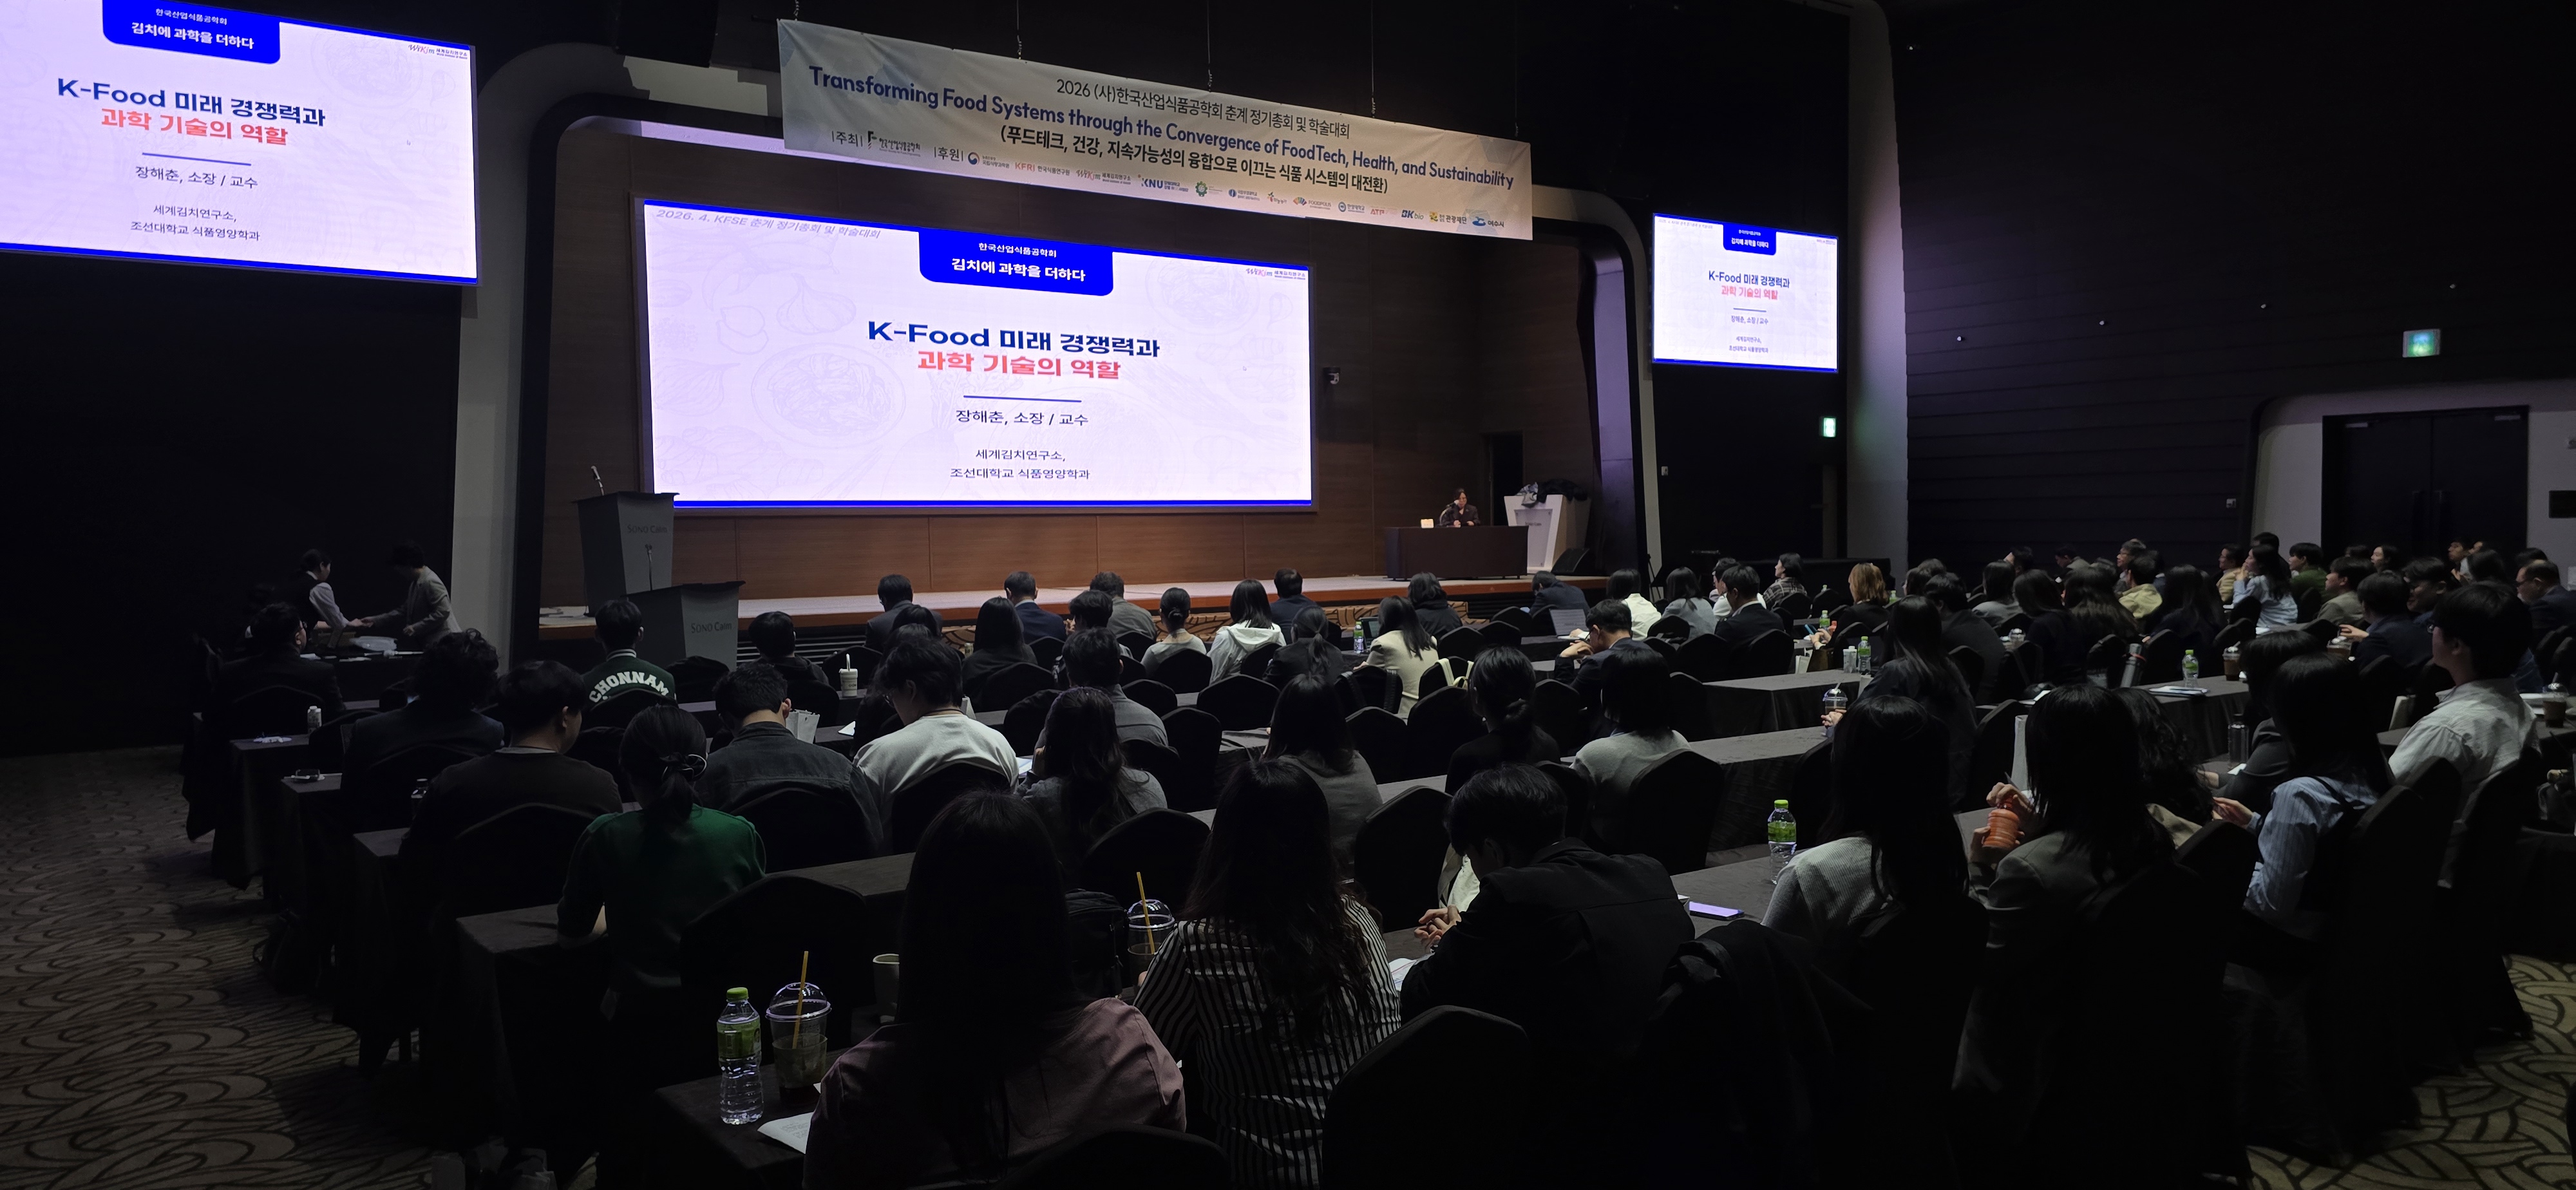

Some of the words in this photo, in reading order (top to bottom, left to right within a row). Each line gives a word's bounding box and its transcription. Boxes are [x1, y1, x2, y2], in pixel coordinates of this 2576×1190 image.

[156, 8, 228, 26] 한국산업식품공학회
[131, 22, 171, 40] 김치에
[174, 27, 213, 44] 과학을
[216, 32, 255, 50] 더하다
[57, 78, 166, 108] K-Food
[175, 91, 223, 115] 미래
[231, 98, 326, 128] 경쟁력과
[1056, 79, 1091, 98] 2026
[1094, 82, 1223, 120] (사)한국산업식품공학회
[1225, 104, 1248, 124] 춘계
[1249, 109, 1294, 131] 정기총회
[1296, 114, 1307, 133] 및
[1308, 117, 1350, 140] 학술대회
[101, 108, 152, 131] 과학
[160, 115, 233, 140] 기술의
[240, 122, 288, 146] 역할
[809, 65, 939, 109] Transforming
[943, 88, 987, 113] Food
[992, 96, 1065, 123] Systems
[1069, 105, 1133, 136] through
[1137, 113, 1162, 139] the
[1166, 123, 1261, 155] Convergence
[1264, 138, 1279, 156] of
[1282, 140, 1349, 168] FoodTech,
[1353, 151, 1398, 176] Health,
[1402, 160, 1426, 178] and
[1429, 162, 1514, 190] Sustainability
[1000, 124, 1068, 154] (푸드테크,
[1073, 134, 1103, 158] 건강,
[1107, 139, 1185, 168] 지속가능성의
[1188, 149, 1238, 174] 융합으로
[1240, 158, 1276, 180] 이끄는
[1279, 164, 1302, 183] 식품
[1305, 167, 1349, 190] 시스템의
[1351, 174, 1388, 194] 대전환)
[135, 165, 184, 185] 장해춘,
[188, 171, 216, 187] 소장
[230, 173, 259, 190] 교수
[1141, 178, 1163, 189] KNU
[153, 204, 238, 224] 세계김치연구소,
[656, 209, 694, 222] 2026.
[698, 213, 710, 223] 4.
[714, 215, 747, 226] KFSE
[131, 221, 189, 236] 조선대학교
[193, 225, 261, 241] 식품영양학과
[978, 242, 1057, 258] 한국산업식품공학회
[952, 258, 996, 276] 김치에
[999, 261, 1041, 279] 과학을
[1045, 266, 1086, 283] 더하다
[1709, 270, 1741, 283] K-Food
[1744, 274, 1759, 285] 미래
[1721, 285, 1737, 296] 과학
[868, 321, 990, 348] K-Food
[1000, 329, 1052, 352] 미래
[1060, 333, 1160, 358] 경쟁력과
[918, 350, 974, 373] 과학
[983, 354, 1062, 377] 기술의
[1070, 359, 1121, 380] 역할
[956, 409, 1009, 426] 장해춘,
[1014, 410, 1043, 426] 소장
[1048, 413, 1055, 426] /
[1059, 412, 1088, 428] 교수
[976, 449, 1066, 463] 세계김치연구소,
[951, 467, 1014, 480] 조선대학교
[1018, 468, 1090, 481] 식품영양학과
[589, 671, 668, 703] CHONNAM
